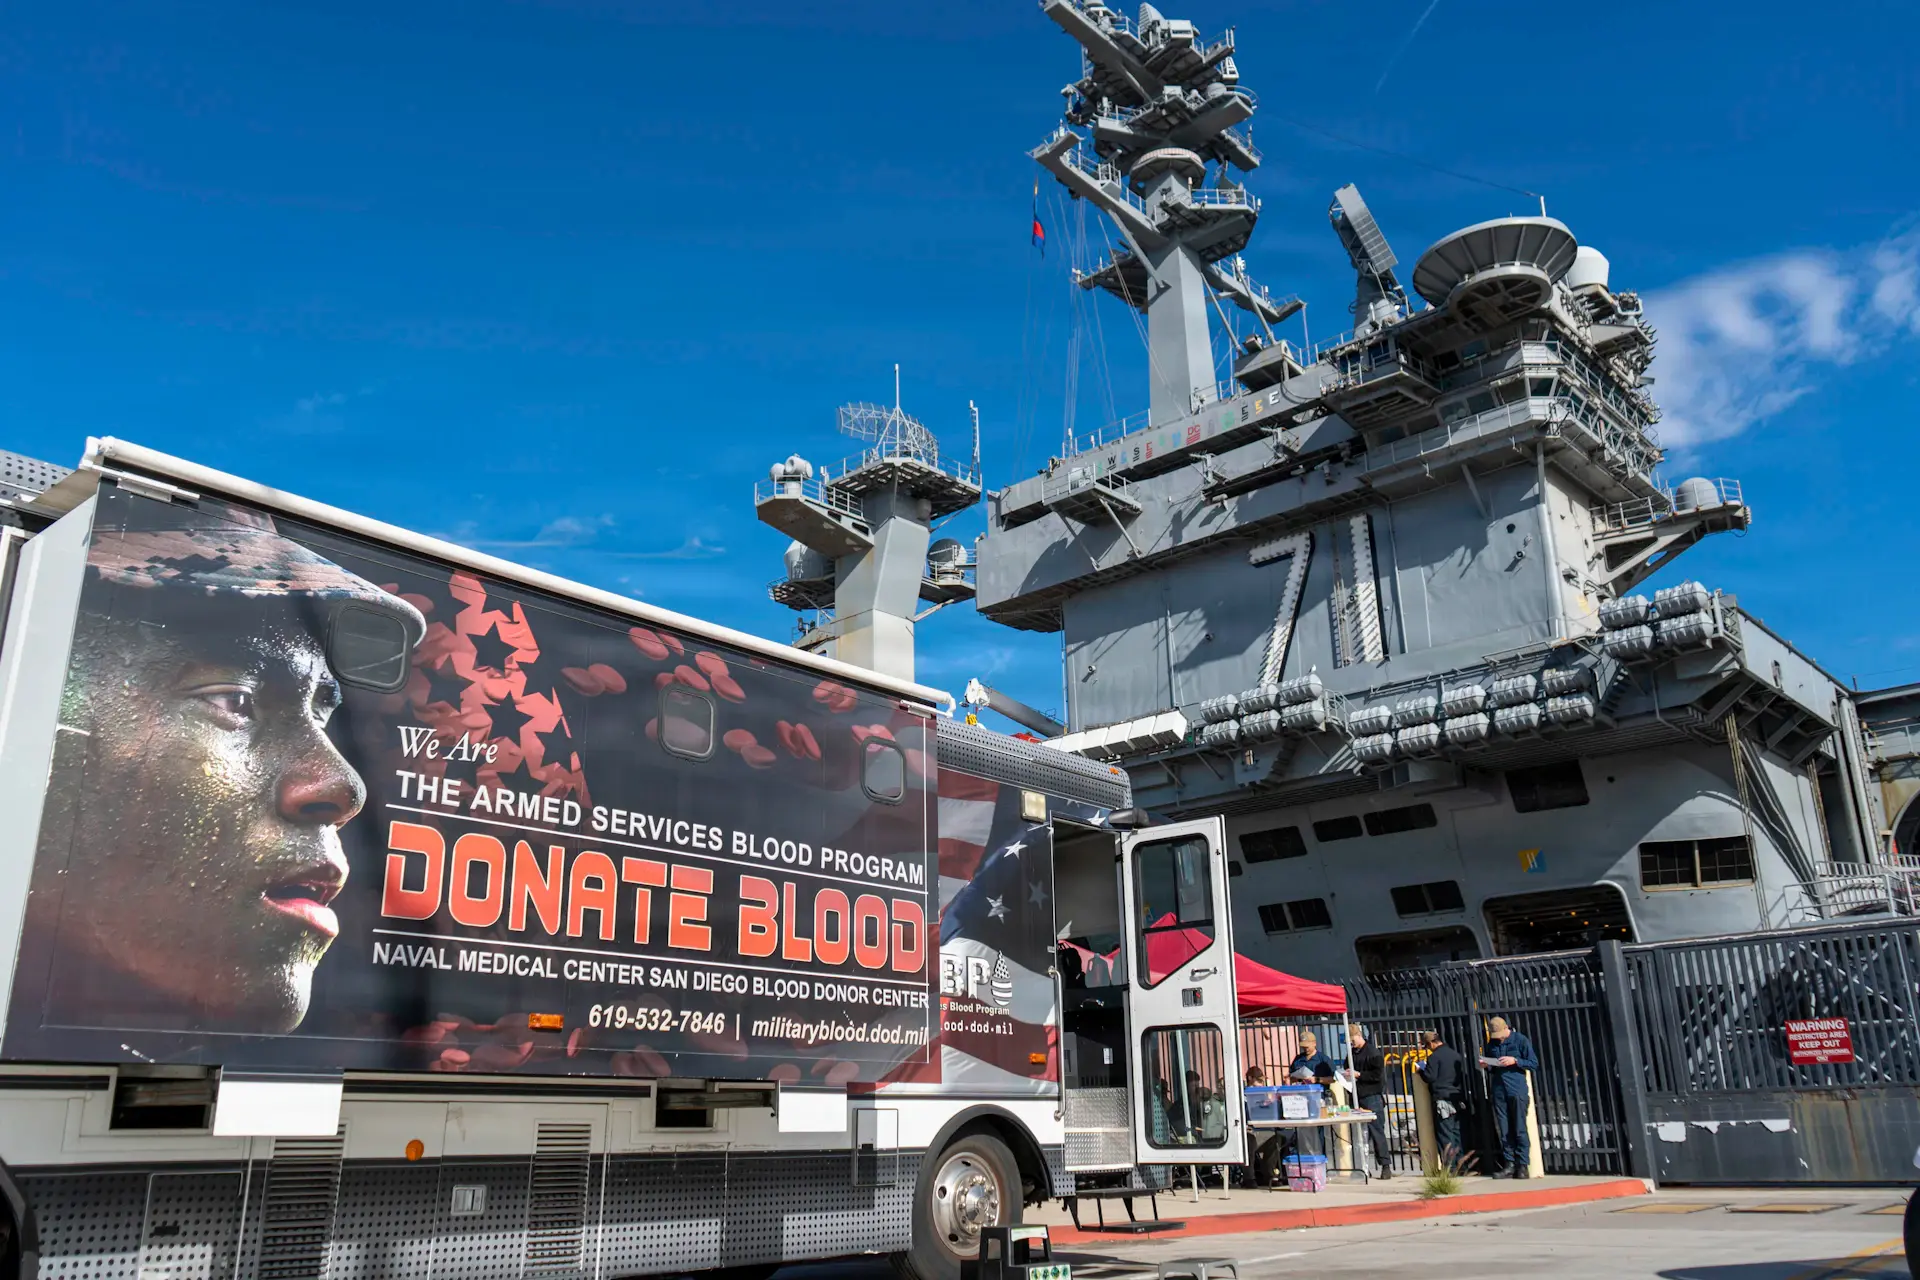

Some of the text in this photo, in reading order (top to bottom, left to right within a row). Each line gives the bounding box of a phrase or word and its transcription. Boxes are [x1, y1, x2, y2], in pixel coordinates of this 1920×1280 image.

[1268, 390, 1280, 405] E
[1249, 512, 1388, 688] 71
[397, 725, 499, 764] We Are
[396, 769, 924, 885] THE ARMED SERVICES BLOOD PROGRAM
[381, 820, 925, 973] DONATE BLOOD
[372, 942, 929, 1009] NAVAL MEDICAL CENTER SAN DIEGO BLOOD DONOR CENTER
[588, 1004, 929, 1046] 619-532-7846 militaryblood.dod.mil
[950, 1001, 973, 1013] Blood
[975, 1003, 1010, 1016] Program
[1788, 1020, 1845, 1032] WARNING
[1788, 1032, 1828, 1041] RESTRICTED
[1798, 1039, 1840, 1049] KEEP OUT
